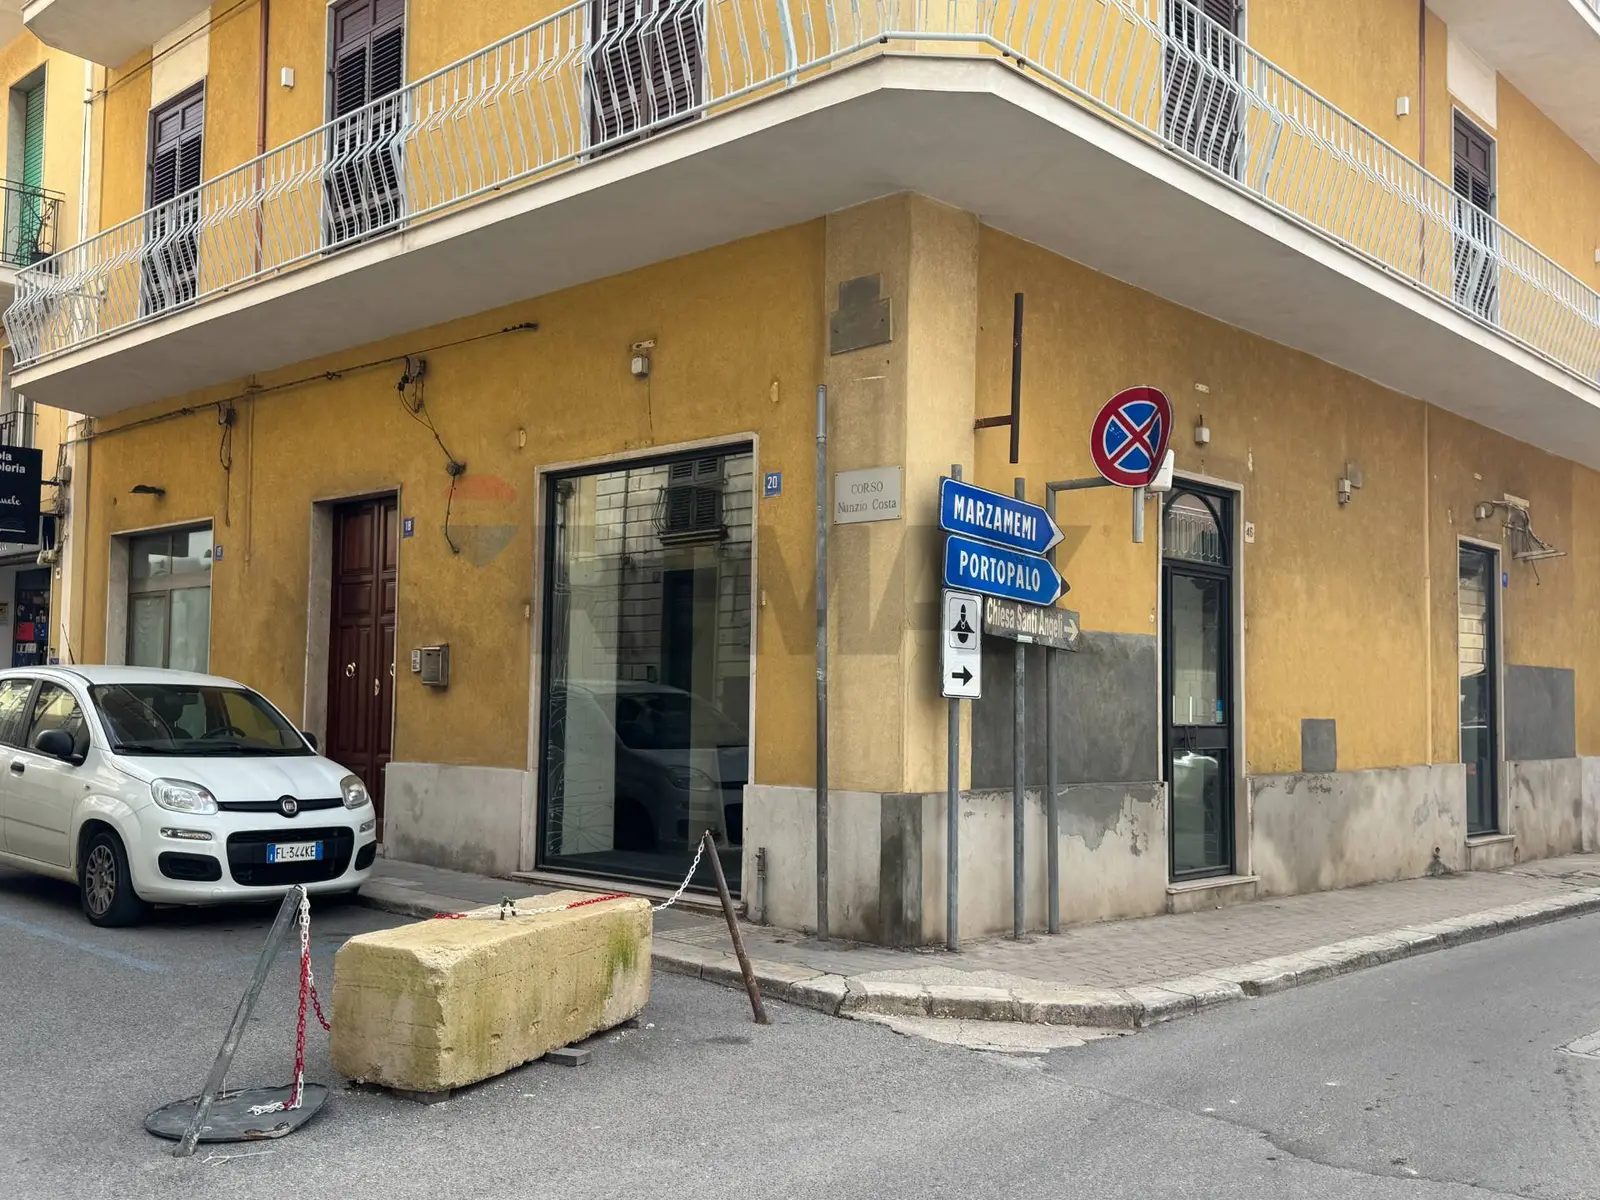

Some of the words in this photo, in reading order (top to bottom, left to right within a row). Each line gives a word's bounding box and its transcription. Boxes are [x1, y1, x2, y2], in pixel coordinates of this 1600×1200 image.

[767, 476, 778, 488] 20
[851, 481, 884, 494] CORSO
[838, 502, 868, 514] Nunzio
[872, 499, 897, 510] Costa
[954, 494, 1036, 541] MARZAMEMI
[960, 550, 1040, 592] PORTOPALO
[986, 597, 1014, 628] Chiesa
[1016, 604, 1037, 633] Santi
[1039, 609, 1063, 642] Angeli
